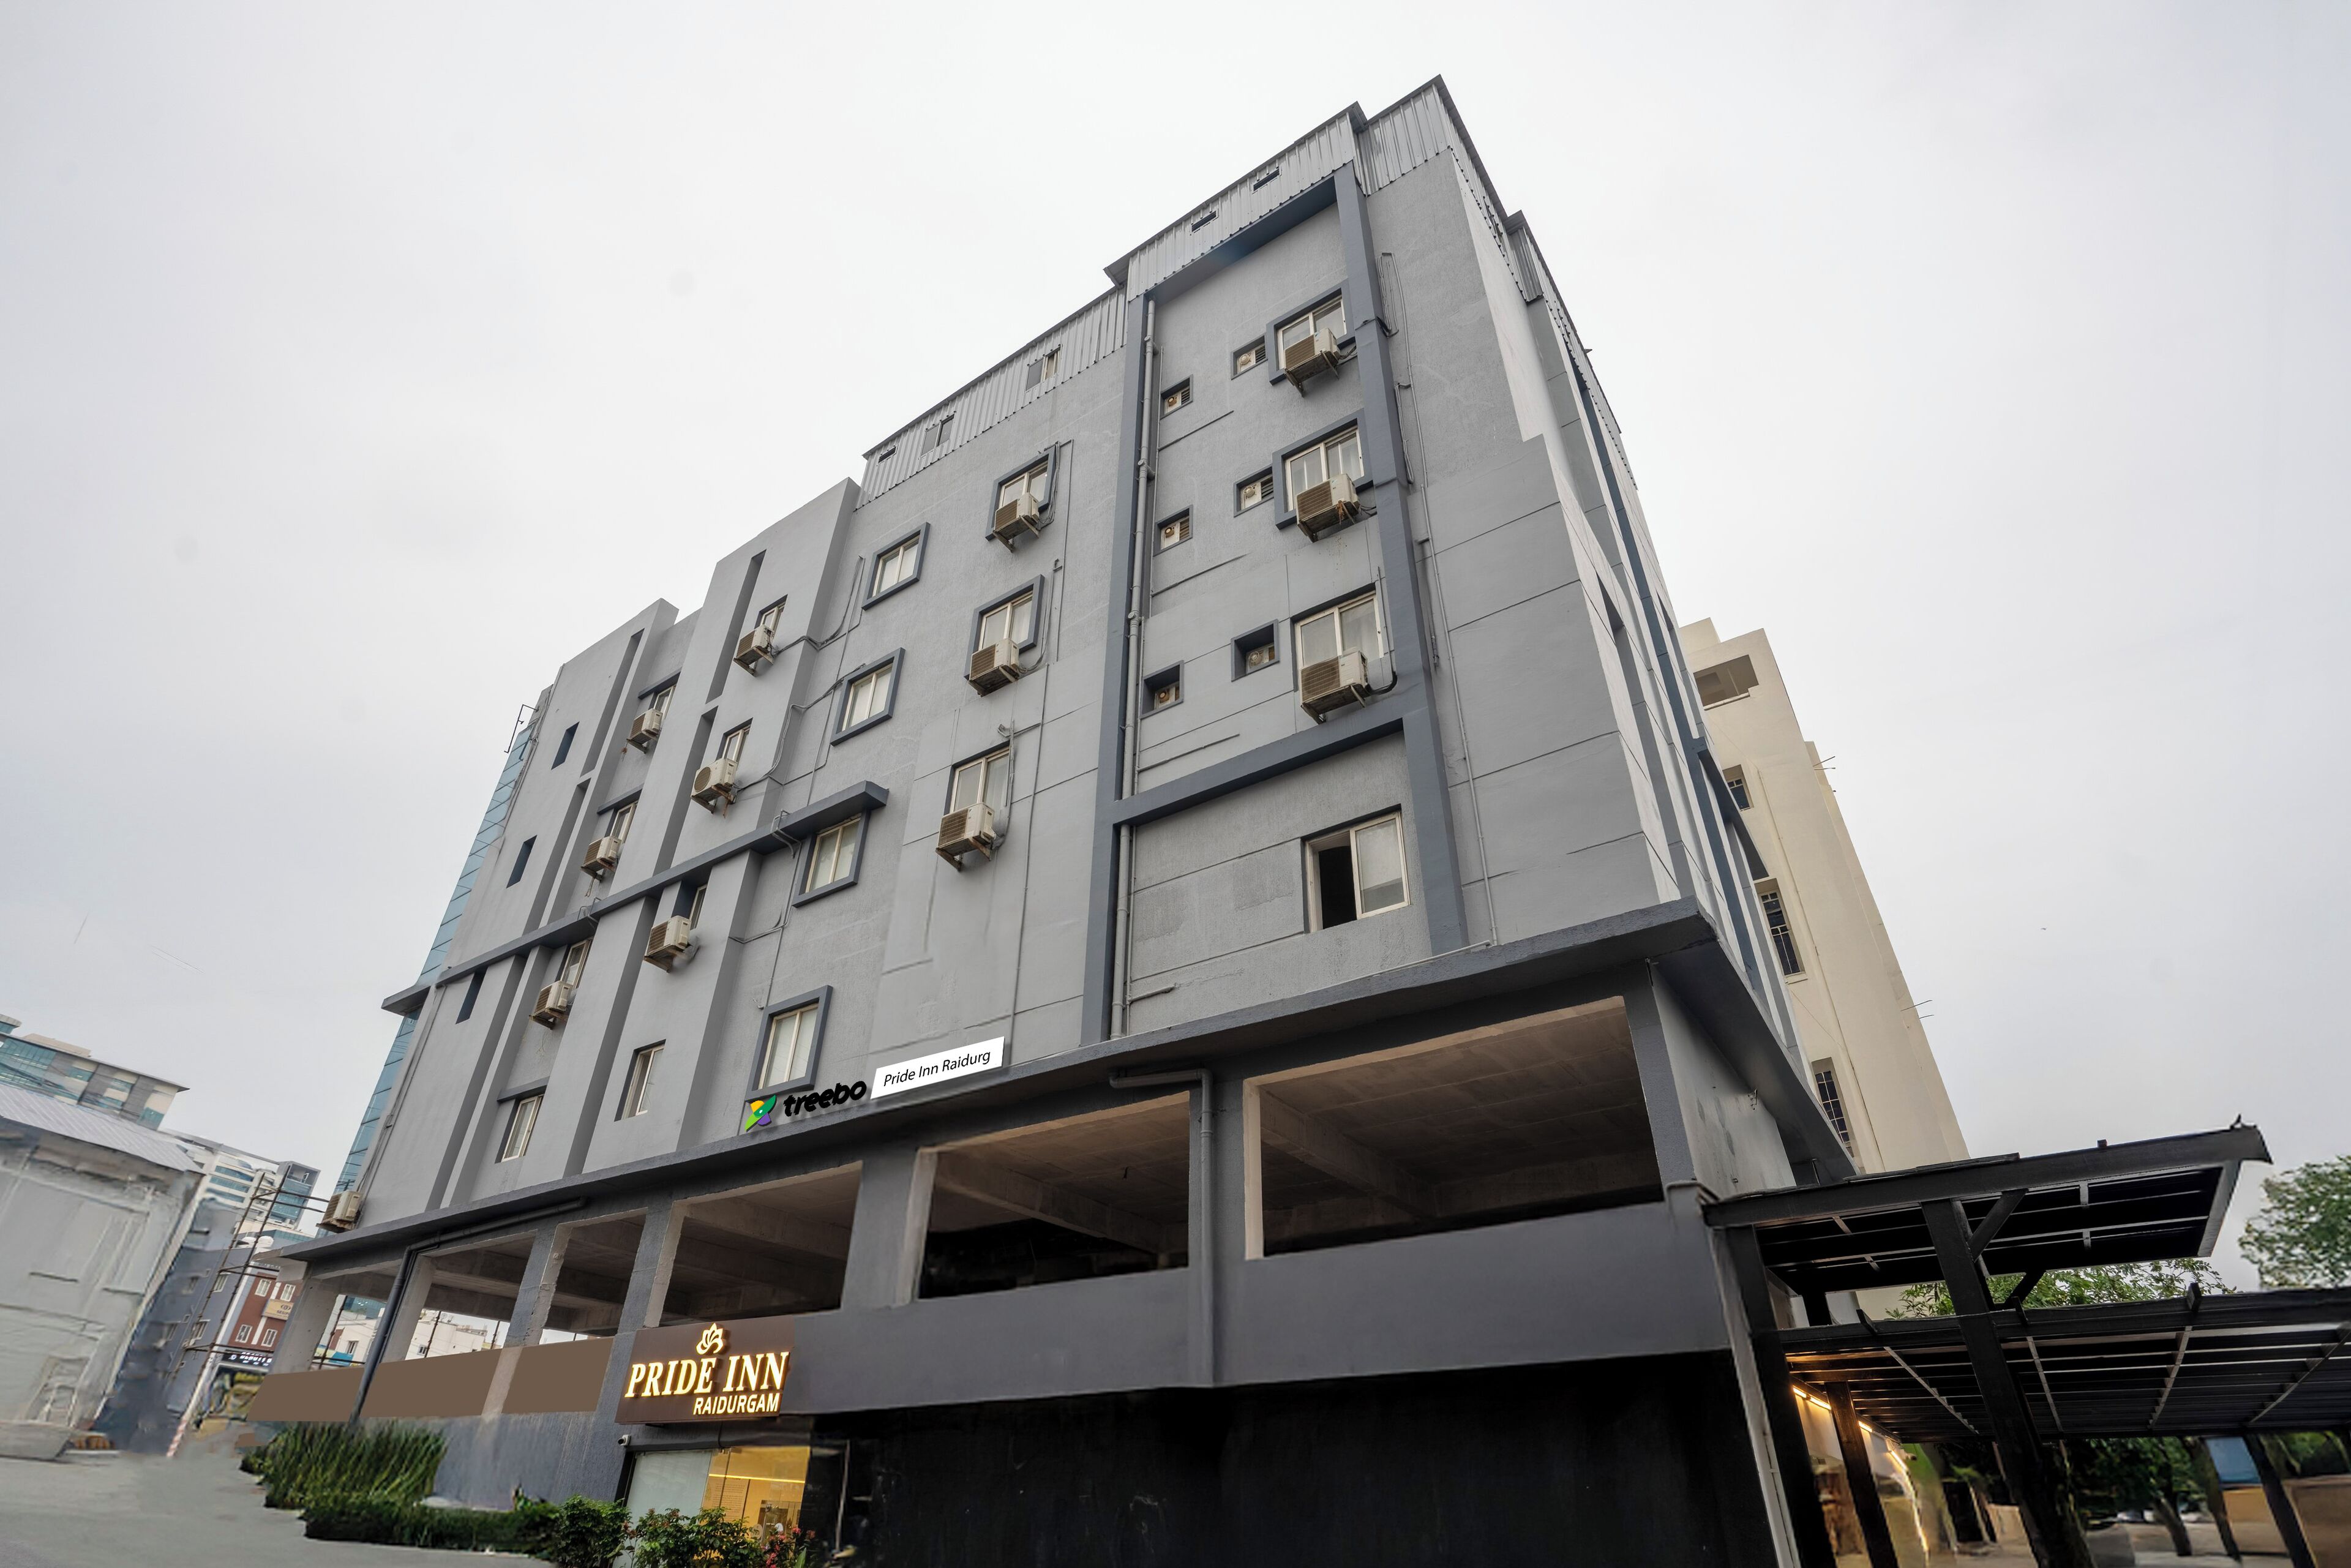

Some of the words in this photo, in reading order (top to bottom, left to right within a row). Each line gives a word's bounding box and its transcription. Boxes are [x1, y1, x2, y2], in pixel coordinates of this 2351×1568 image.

[883, 1069, 915, 1086] Pride
[918, 1064, 939, 1078] Inn
[942, 1051, 991, 1071] Raidurg
[784, 1081, 867, 1116] treebo
[624, 1357, 716, 1398] PRIDE
[722, 1351, 789, 1392] INN
[693, 1392, 780, 1415] RAIDURGAM
